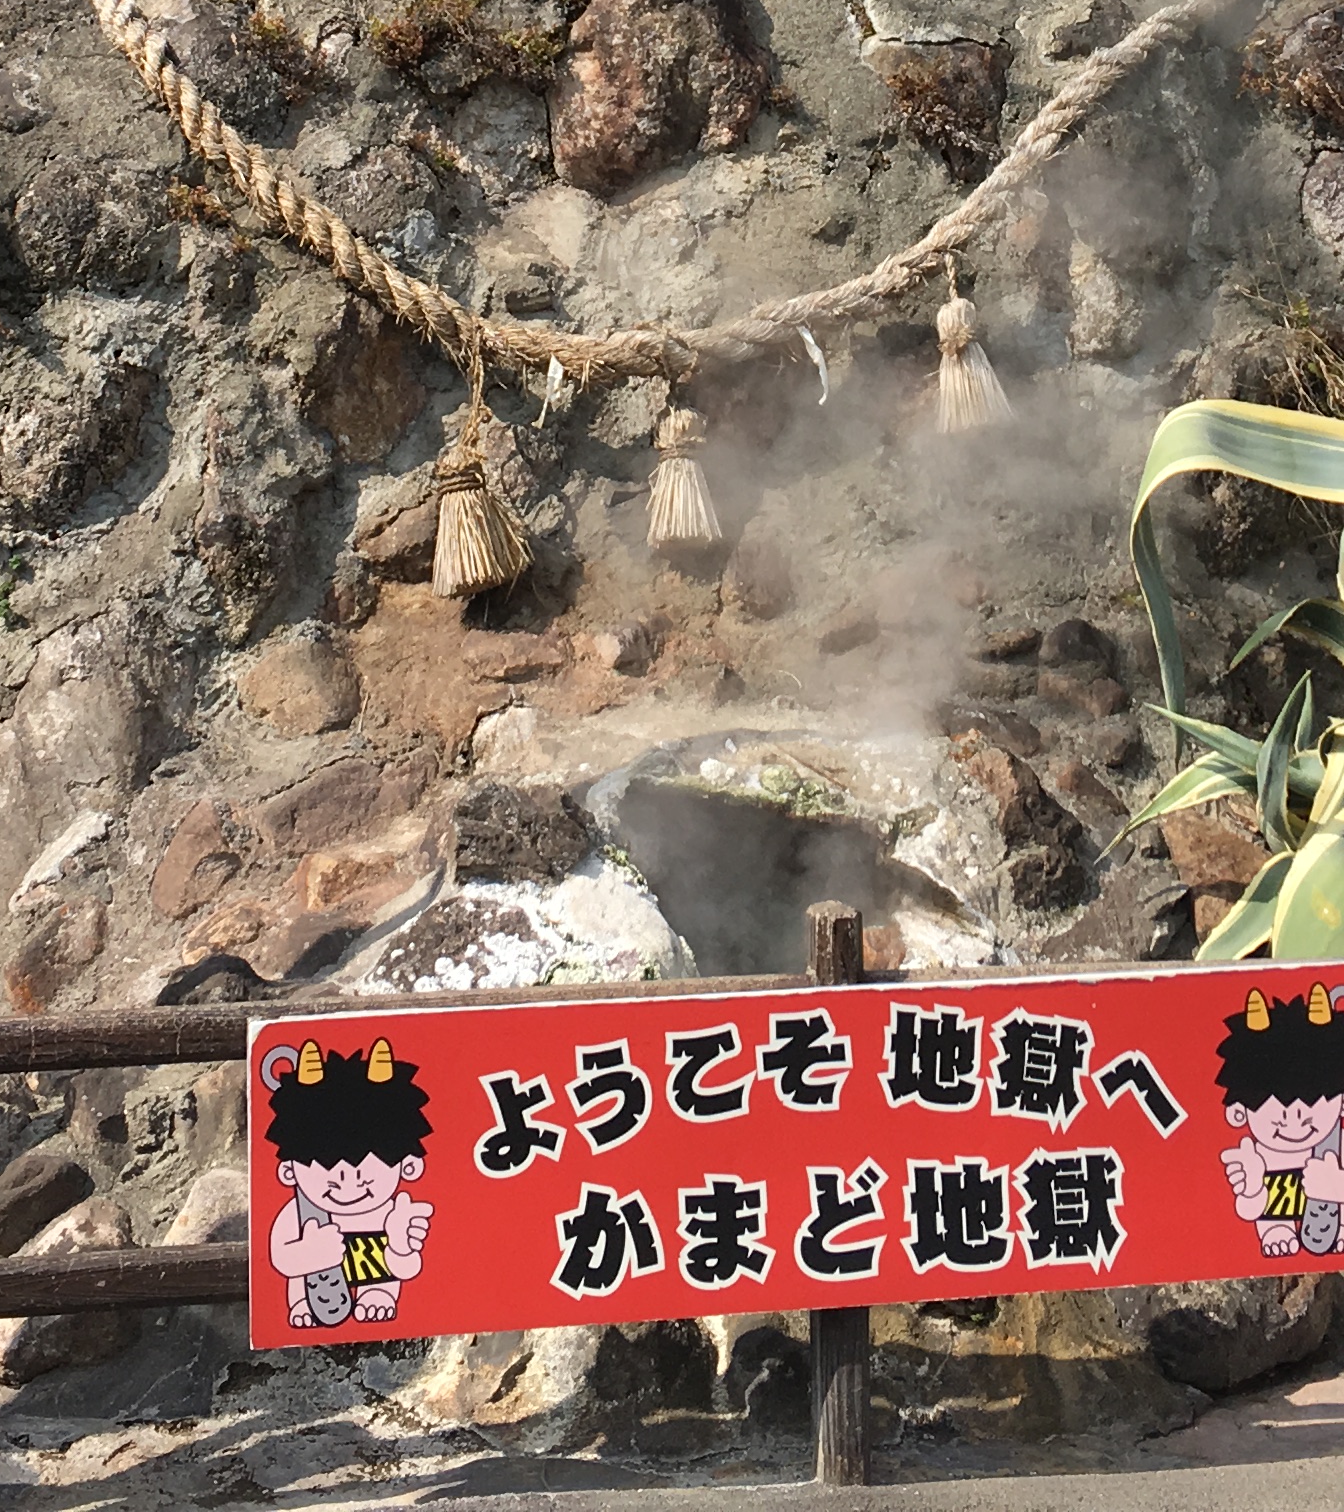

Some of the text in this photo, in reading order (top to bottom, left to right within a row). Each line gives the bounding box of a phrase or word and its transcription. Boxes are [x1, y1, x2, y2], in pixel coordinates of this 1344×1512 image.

[472, 1002, 1189, 1179] ようこそ 地獄へ
[550, 1146, 1129, 1301] かまど地獄
